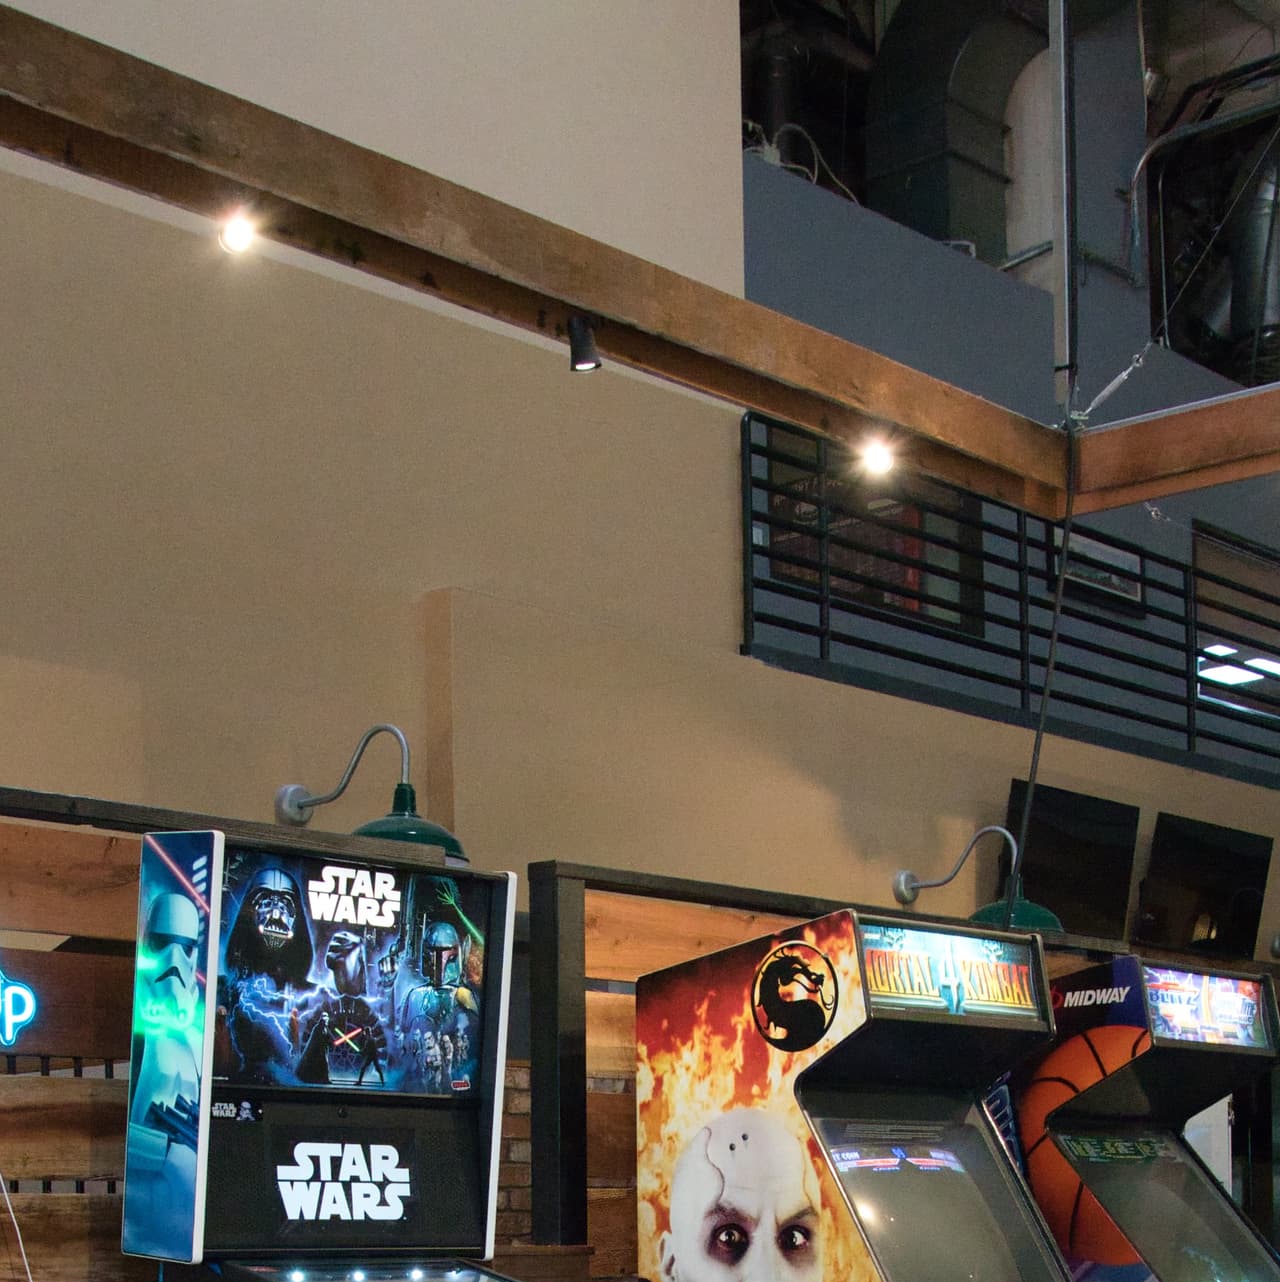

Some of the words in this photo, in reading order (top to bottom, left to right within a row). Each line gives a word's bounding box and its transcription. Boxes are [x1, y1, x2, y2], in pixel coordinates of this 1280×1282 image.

[308, 865, 401, 900] STAR
[308, 890, 401, 928] WARS
[960, 959, 1035, 1009] KOMBAT
[1064, 986, 1130, 1008] MIDWAY
[277, 1142, 411, 1182] STAR
[277, 1180, 411, 1222] WARS
